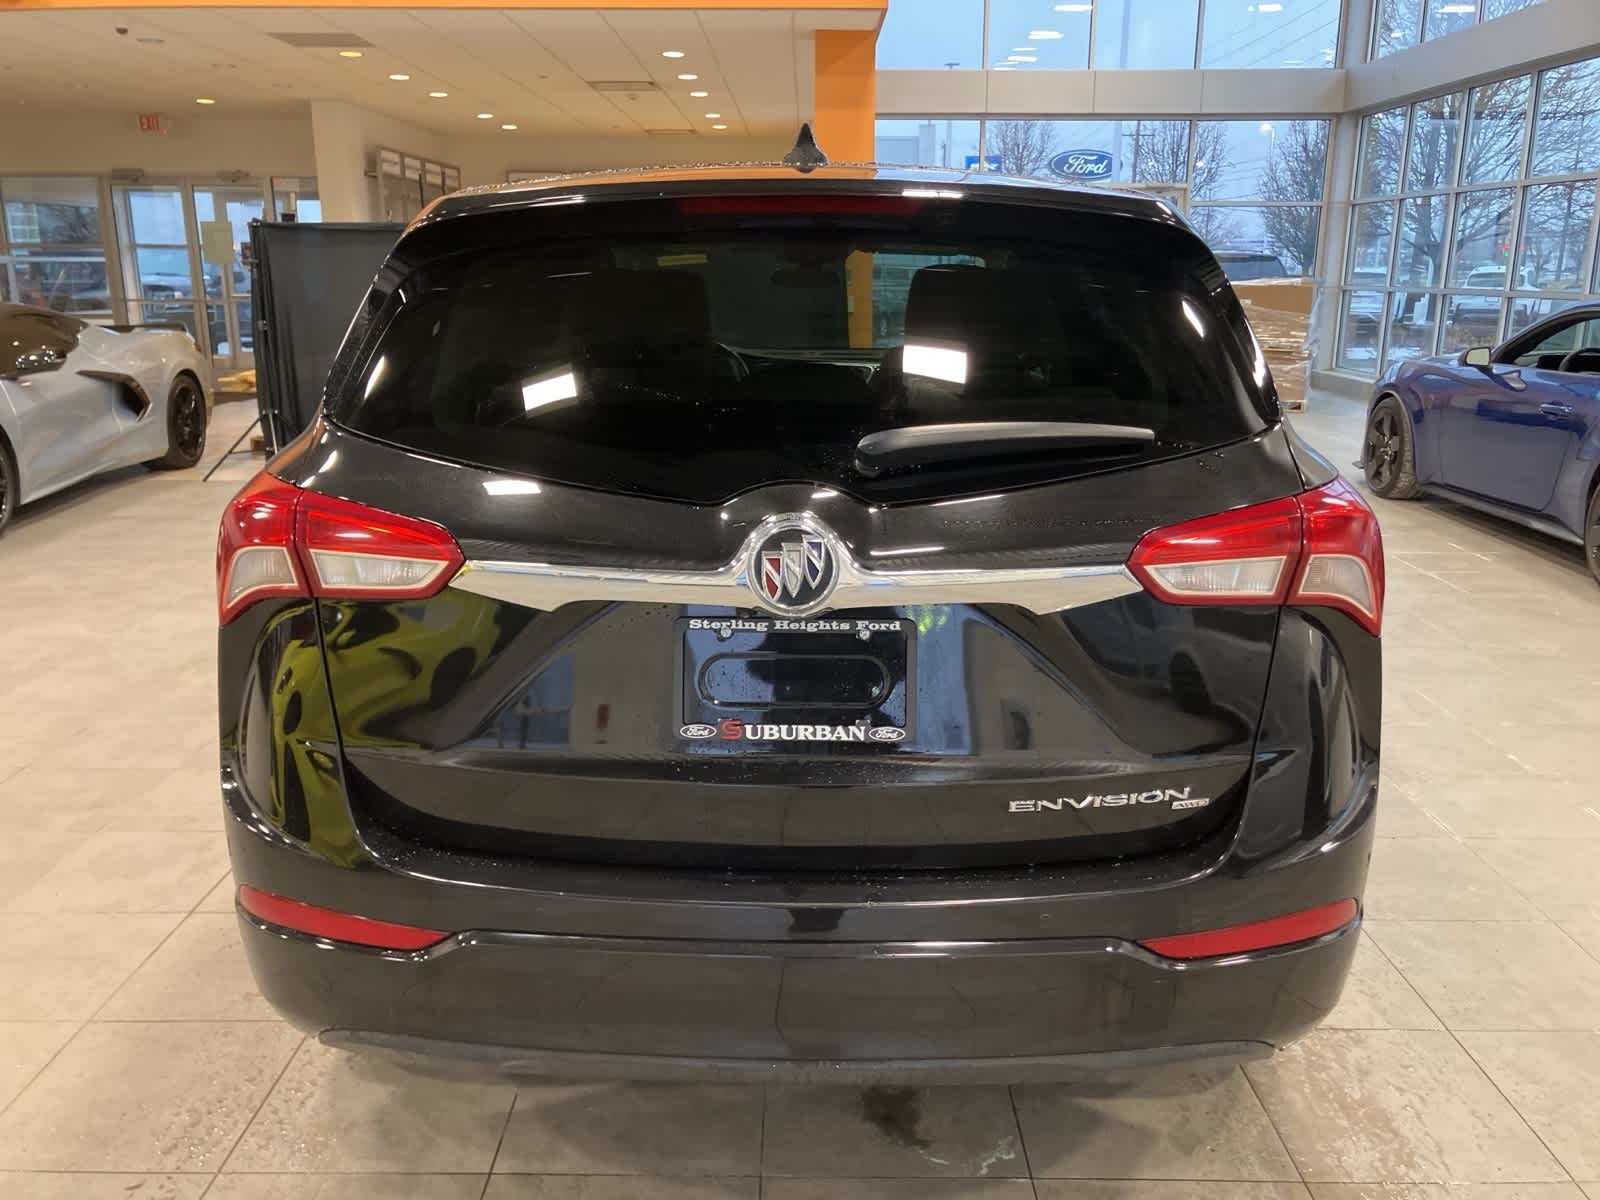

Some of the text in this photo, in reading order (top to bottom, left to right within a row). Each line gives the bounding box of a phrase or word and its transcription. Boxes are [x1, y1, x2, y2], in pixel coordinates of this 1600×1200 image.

[1063, 154, 1107, 174] Ford
[688, 619, 902, 633] Sterling Heights Ford
[719, 719, 866, 742] SUBURBAN
[1008, 786, 1190, 813] ENVISION
